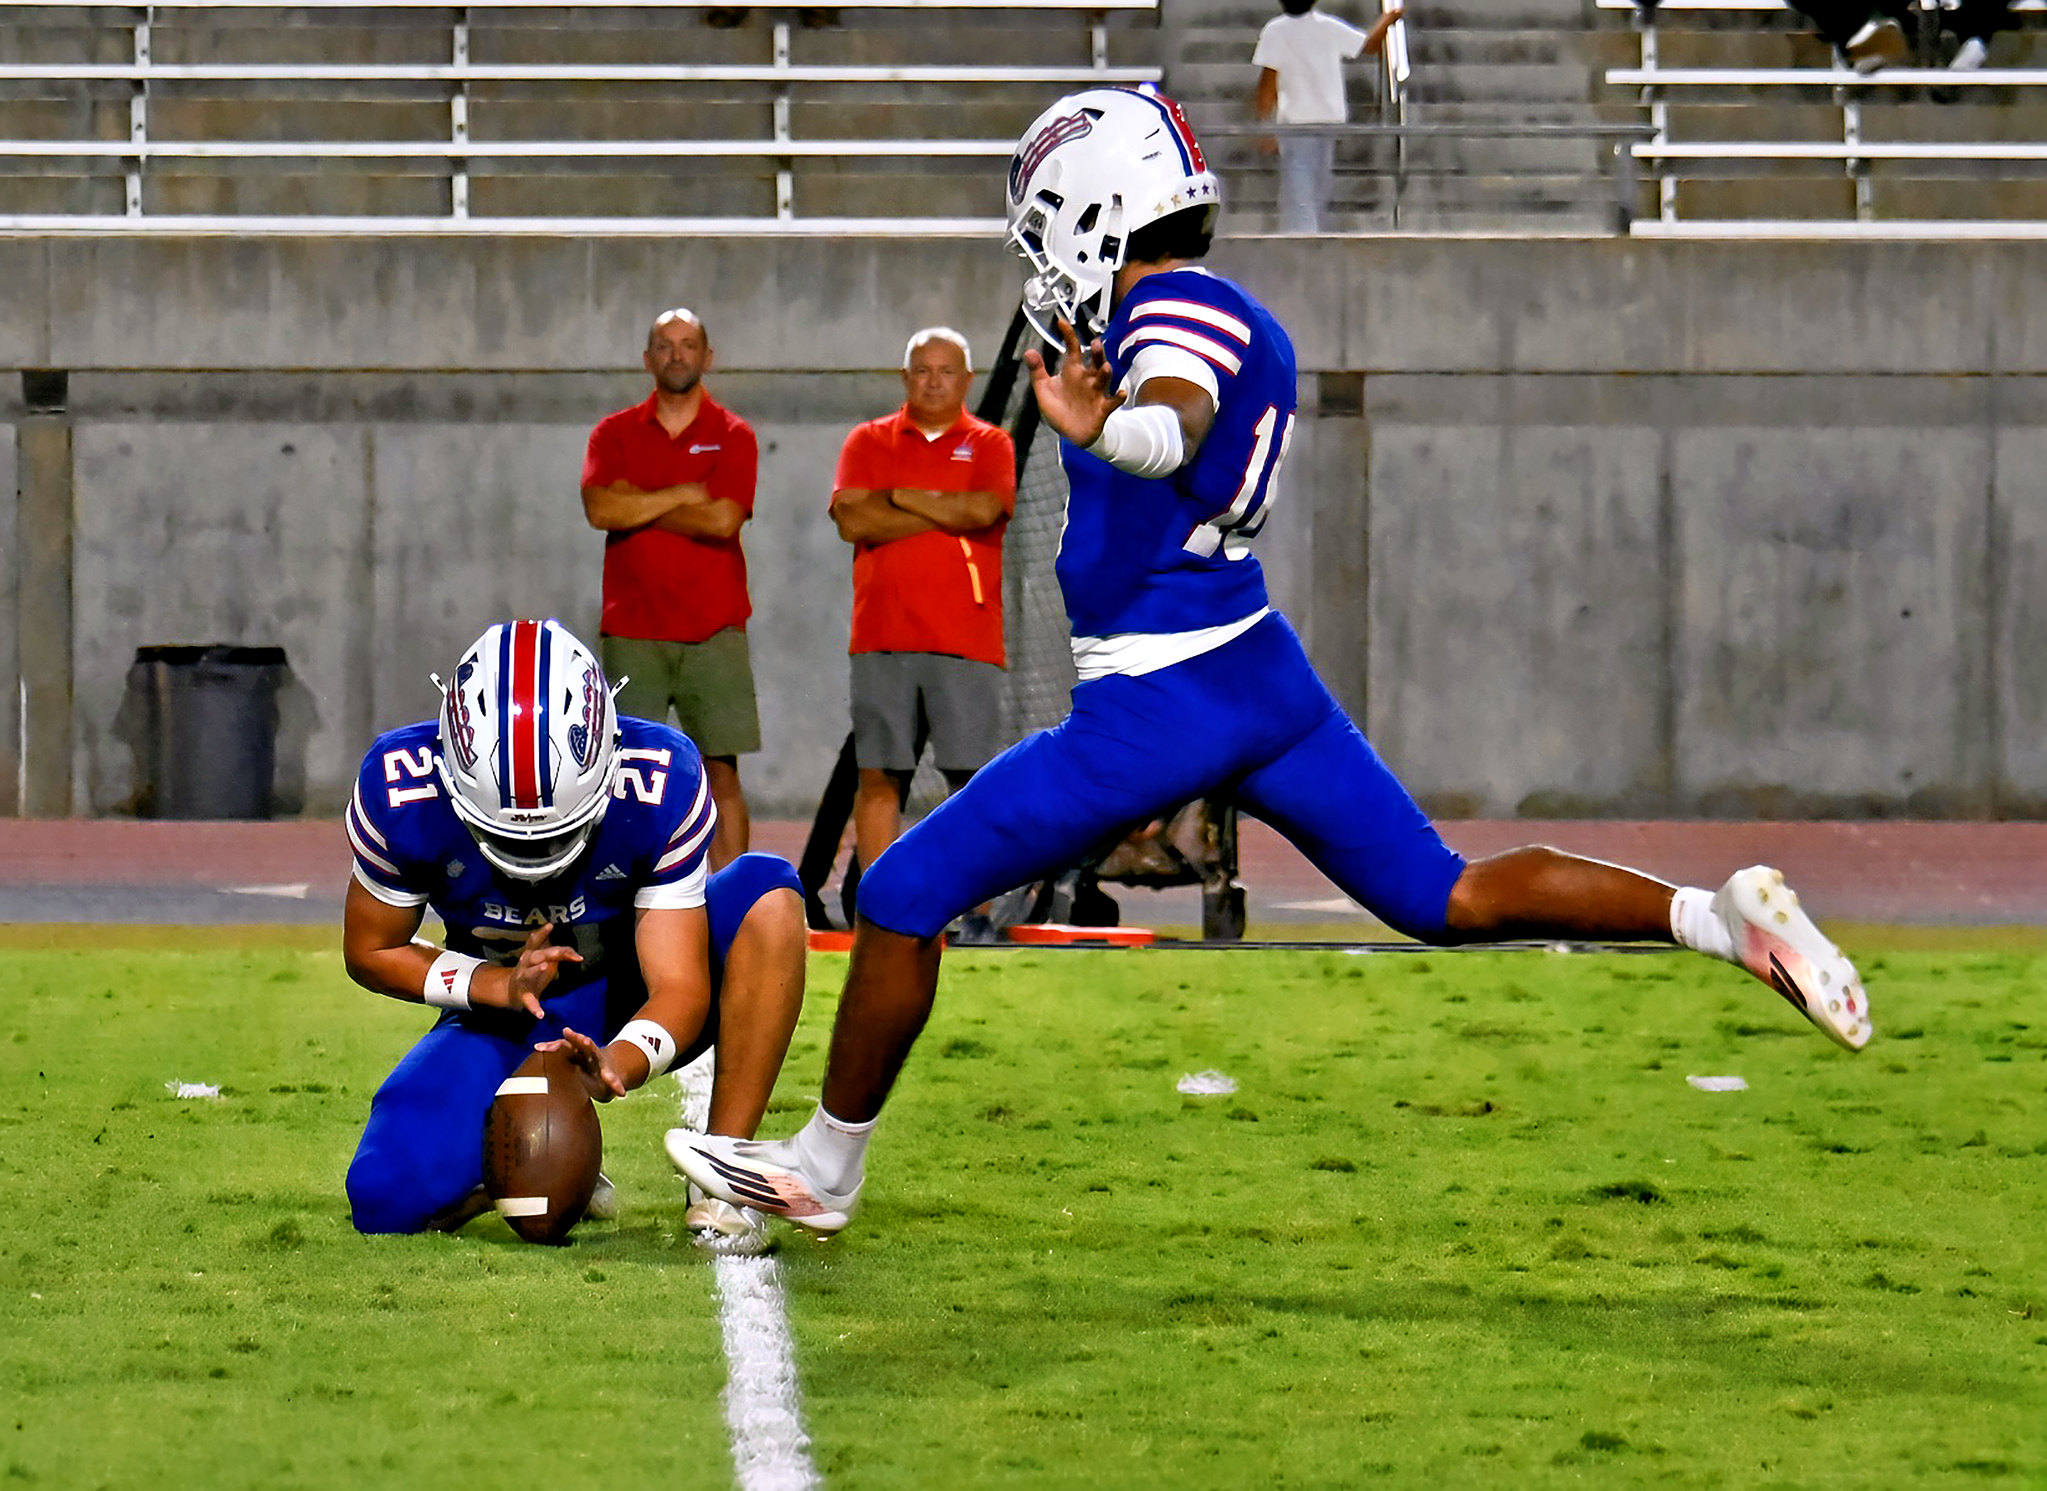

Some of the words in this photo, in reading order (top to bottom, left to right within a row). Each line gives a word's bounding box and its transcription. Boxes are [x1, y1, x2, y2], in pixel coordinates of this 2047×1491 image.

[383, 745, 438, 808] 21
[613, 748, 672, 805] 21
[484, 895, 586, 925] BEARS
